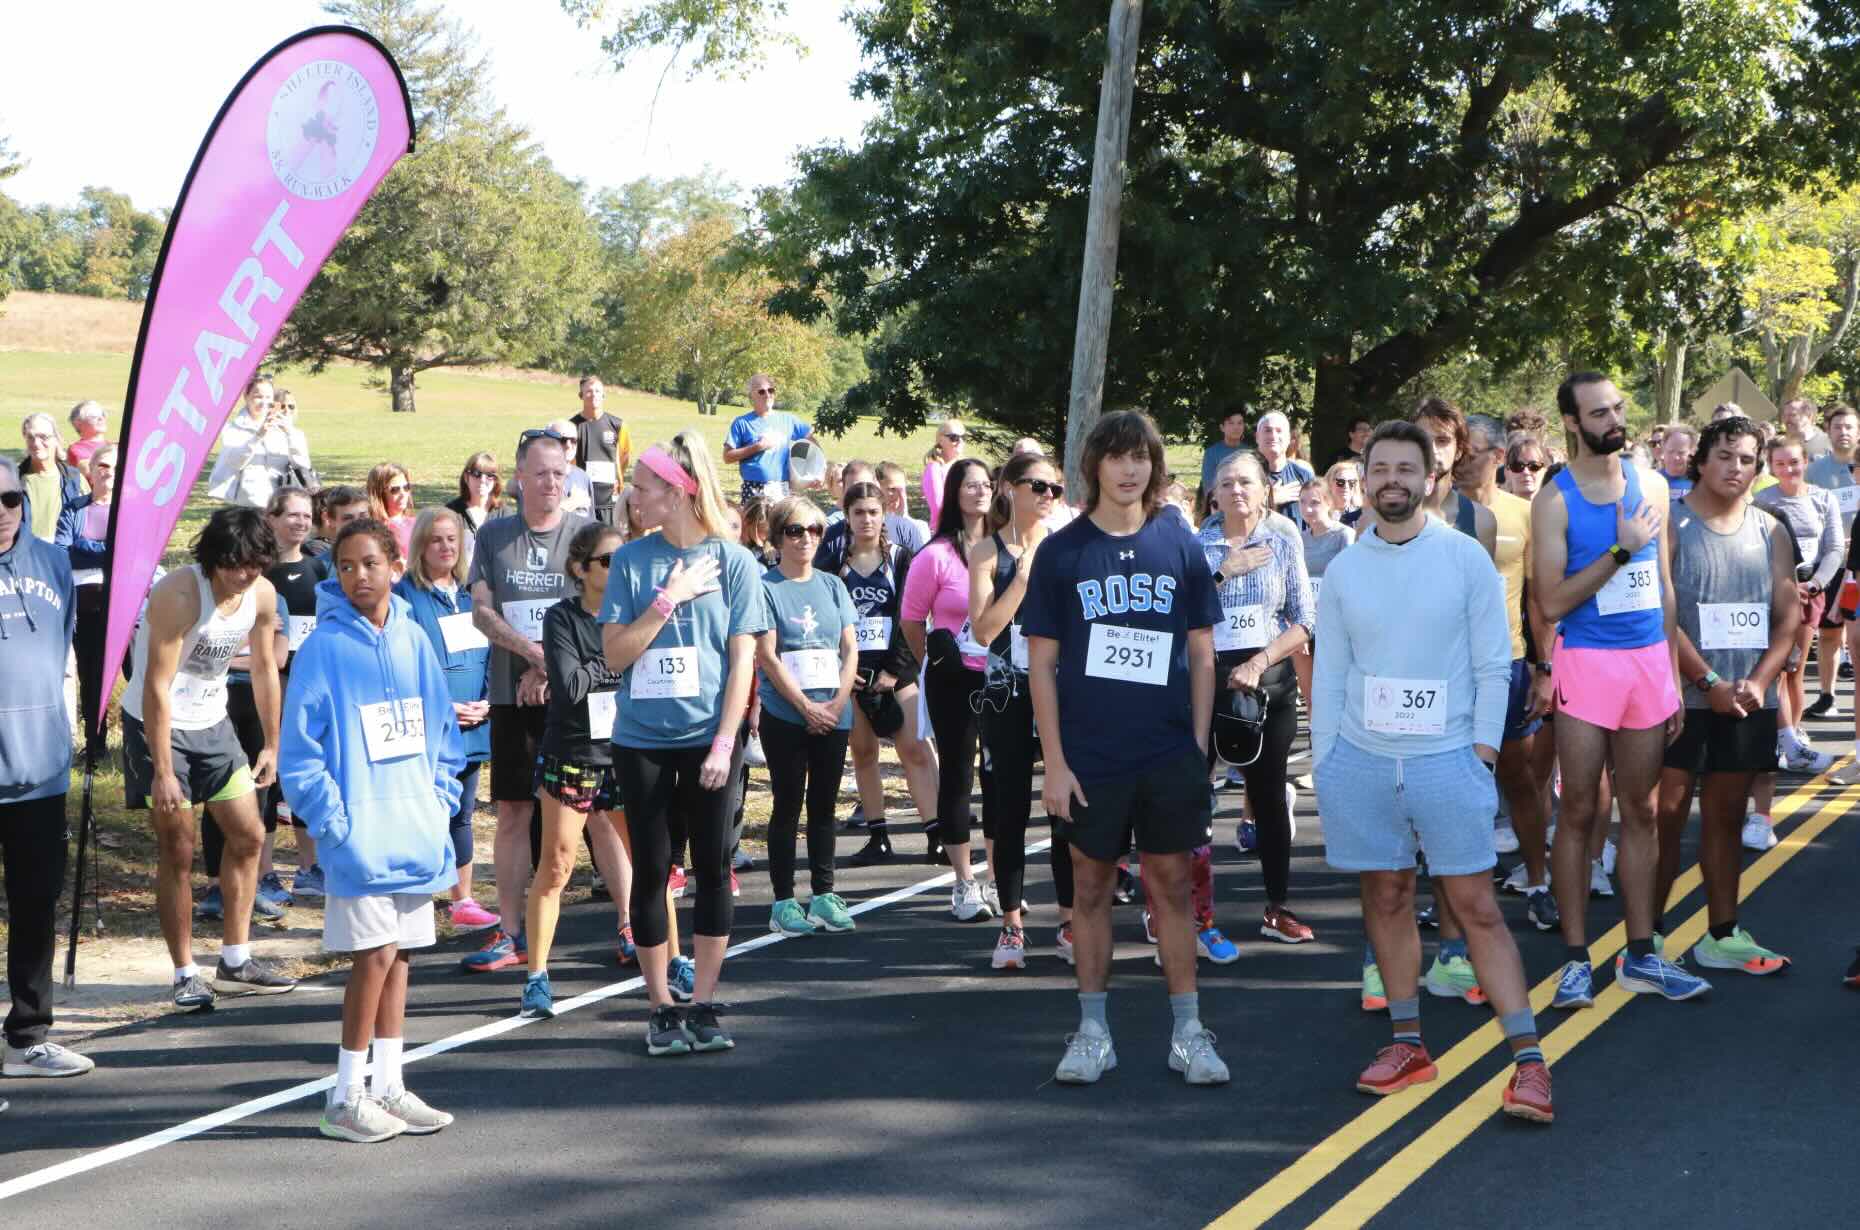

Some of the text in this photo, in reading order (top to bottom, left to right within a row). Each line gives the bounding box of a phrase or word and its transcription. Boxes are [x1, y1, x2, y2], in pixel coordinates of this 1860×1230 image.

[135, 200, 304, 506] START
[506, 568, 564, 587] HERREN
[1627, 570, 1651, 588] 383
[852, 587, 888, 603] OSS
[1077, 573, 1176, 620] ROSS
[1230, 615, 1255, 629] 266
[1730, 611, 1760, 627] 100
[659, 657, 685, 674] 133
[1104, 645, 1153, 669] 2931
[1402, 690, 1436, 708] 367
